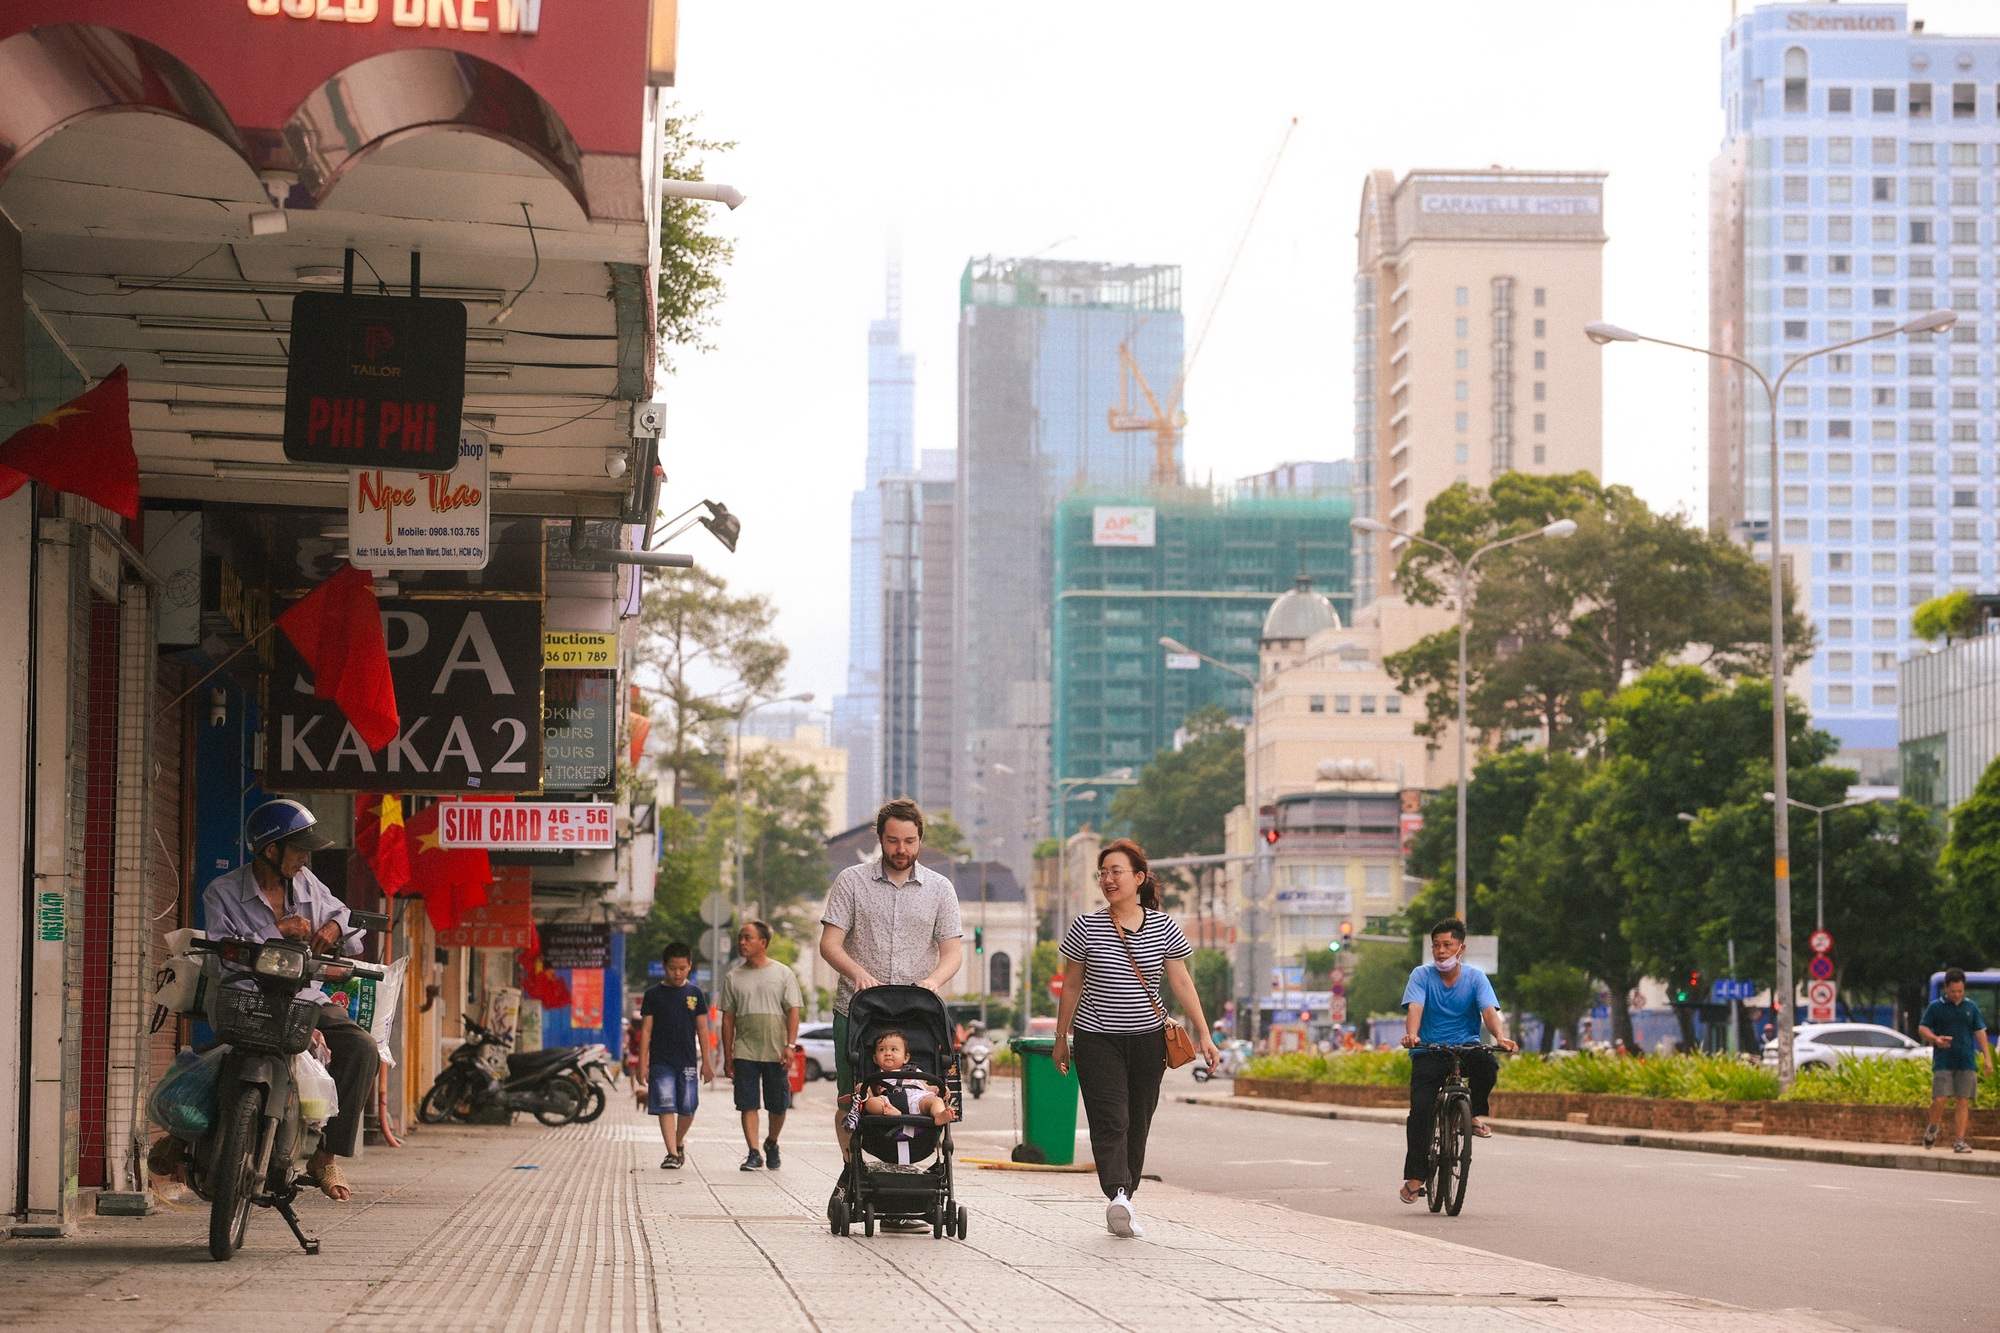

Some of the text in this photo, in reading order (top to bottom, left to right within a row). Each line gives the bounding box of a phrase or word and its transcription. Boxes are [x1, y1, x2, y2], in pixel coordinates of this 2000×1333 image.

[1787, 11, 1896, 31] Sheraton
[1426, 197, 1593, 214] CARAVELLE HOTEL
[352, 365, 401, 377] TAILOR
[419, 473, 481, 513] Thao
[397, 527, 480, 537] Mobile: 0908.103.765
[356, 547, 369, 557] Add:
[370, 548, 379, 557] 116
[380, 549, 387, 557] Le
[397, 548, 408, 557] Ben
[409, 548, 425, 557] Thanh
[426, 548, 440, 558] Ward,
[459, 548, 471, 557] HCM
[472, 548, 483, 560] City
[563, 652, 582, 661] 071
[588, 652, 608, 662] 789
[544, 727, 593, 739] OURS
[544, 746, 595, 759] OURS
[556, 765, 607, 780] TICKETS
[548, 809, 569, 824] 4G
[586, 809, 608, 824] 5G
[446, 808, 541, 841] SIM CARD
[548, 826, 609, 842] Esim
[438, 929, 527, 944] COFFEE
